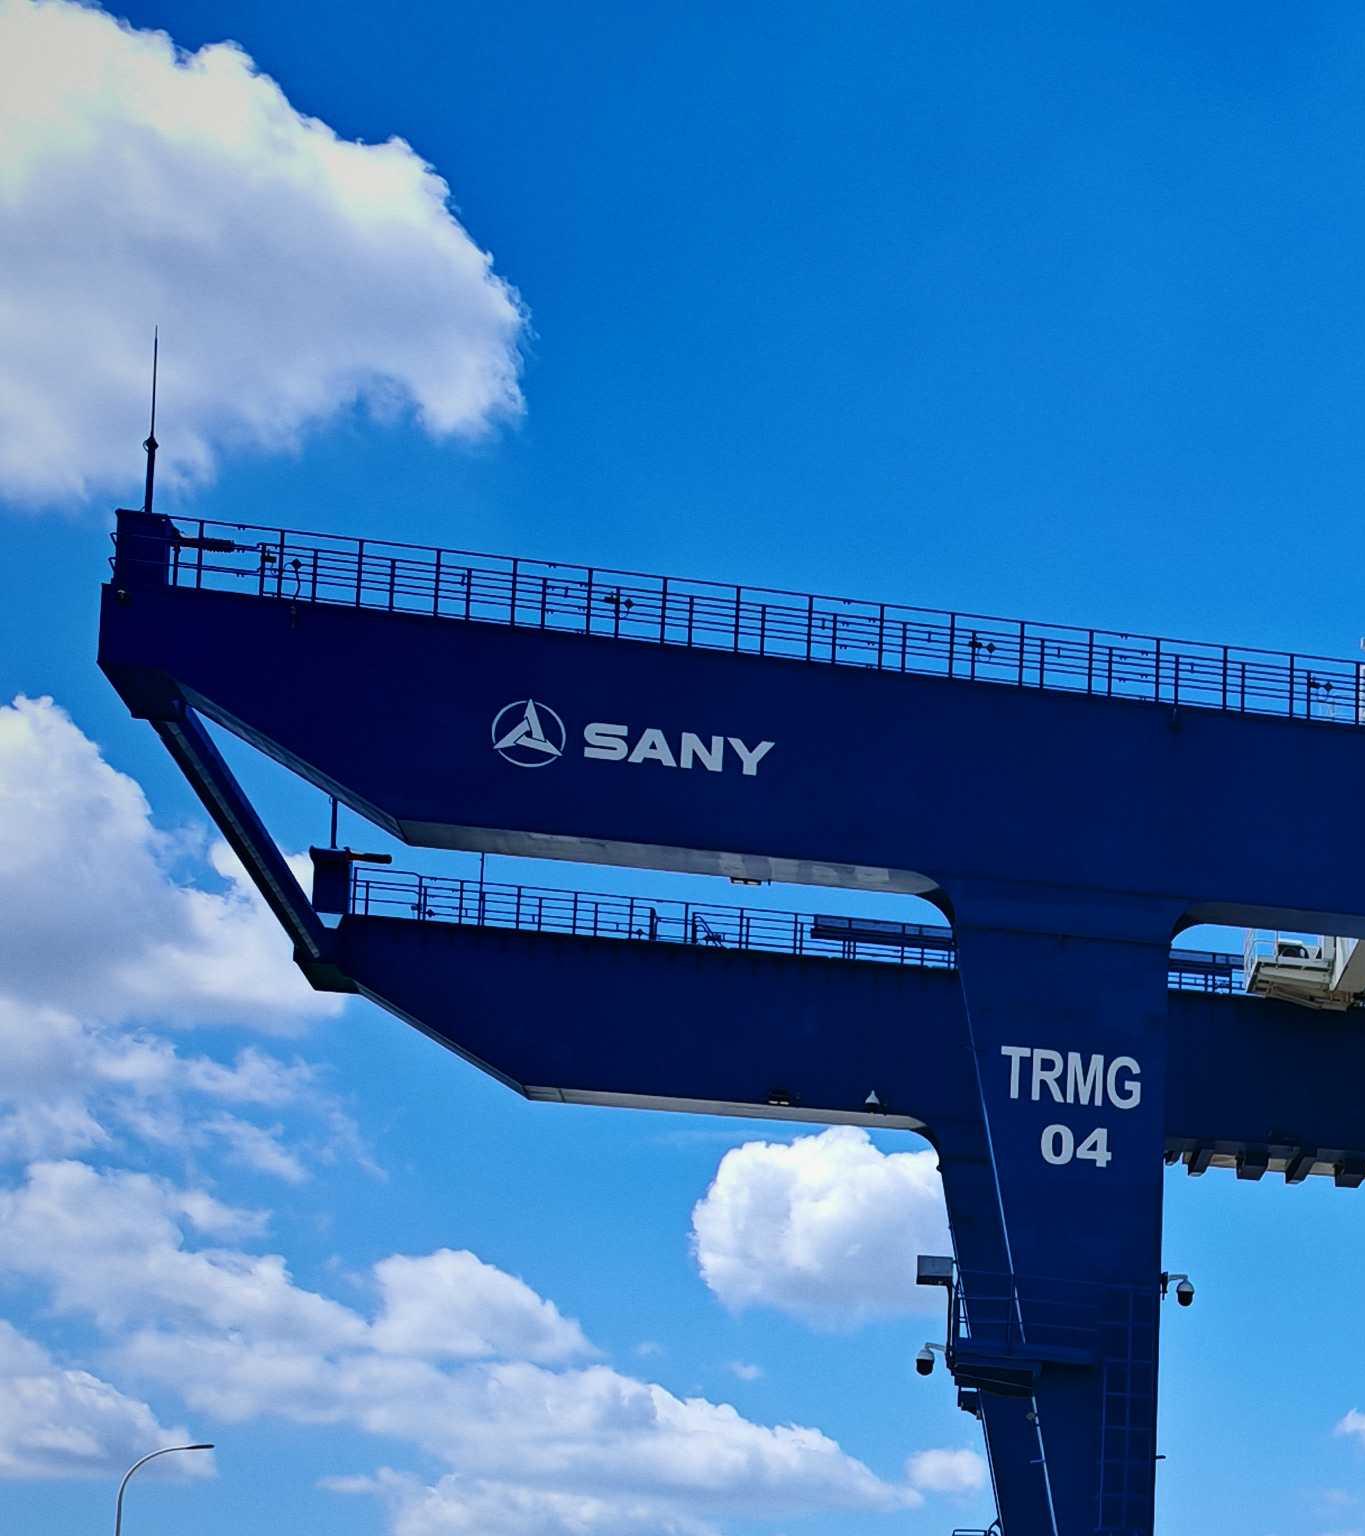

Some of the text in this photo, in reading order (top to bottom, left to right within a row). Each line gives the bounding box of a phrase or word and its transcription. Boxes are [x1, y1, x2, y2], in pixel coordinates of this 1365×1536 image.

[583, 722, 775, 776] SANY
[1001, 1045, 1141, 1109] TRMG
[1040, 1123, 1112, 1168] 04
